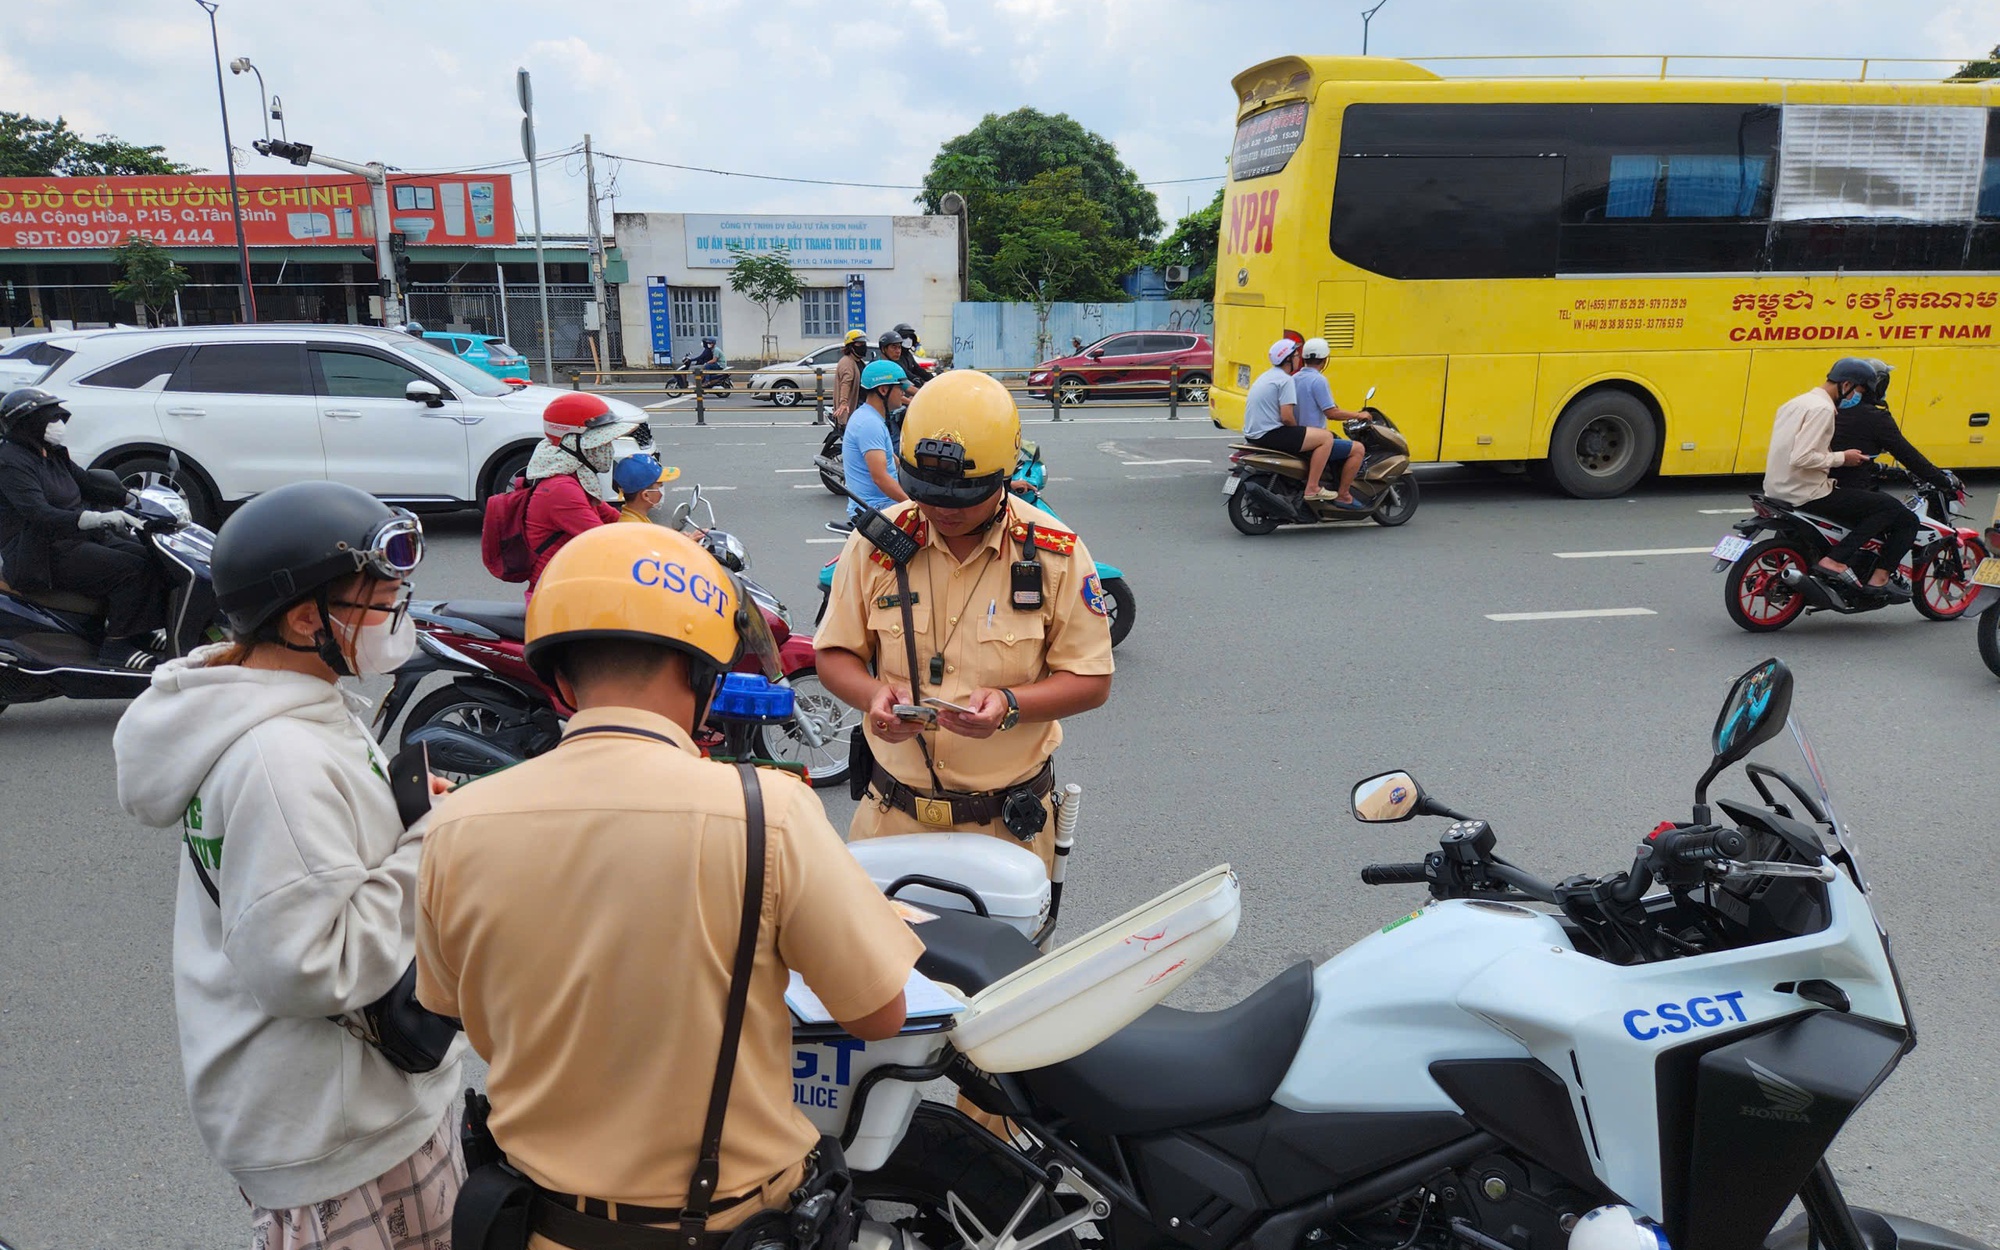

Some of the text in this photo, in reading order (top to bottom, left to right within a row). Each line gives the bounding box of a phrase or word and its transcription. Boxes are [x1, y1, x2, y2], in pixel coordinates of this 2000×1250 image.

[1282, 131, 1299, 139] 15:30
[21, 184, 65, 209] ĐỒ
[72, 184, 114, 208] CŨ
[120, 182, 250, 207] TRƯỜNG
[258, 186, 354, 206] CHINH
[41, 210, 88, 226] Cộng
[93, 210, 133, 225] Hòa,
[136, 209, 177, 224] P.15,
[181, 209, 232, 222] Q.Tân
[815, 221, 829, 230] TÂN
[1227, 189, 1279, 255] NPH
[15, 231, 62, 245] SĐT:
[67, 230, 120, 245] 0907
[173, 228, 215, 243] 444
[697, 235, 710, 252] DỰ
[711, 235, 723, 250] ÁN
[757, 237, 767, 250] XE
[788, 233, 802, 250] KẾT
[804, 237, 832, 250] TRANG
[834, 235, 857, 250] THIẾT
[859, 237, 868, 252] BỊ
[870, 238, 882, 250] HK
[1574, 299, 1586, 309] CPC
[1587, 299, 1607, 311] (+855)
[1608, 299, 1619, 309] 977
[1620, 299, 1628, 309] 85
[1628, 299, 1637, 309] 29
[1637, 299, 1645, 309] 29
[1650, 298, 1661, 309] 979
[1662, 298, 1669, 309] 73
[1670, 298, 1678, 308] 29
[1679, 298, 1687, 308] 29
[1559, 310, 1571, 320] TEL:
[1573, 319, 1582, 330] VN
[1582, 319, 1598, 330] (+84)
[1599, 319, 1607, 329] 28
[1608, 319, 1616, 329] 38
[1617, 319, 1625, 329] 38
[1625, 319, 1633, 329] 53
[1634, 319, 1642, 329] 53
[1646, 318, 1654, 328] 33
[1655, 318, 1667, 328] 776
[1667, 318, 1675, 328] 53
[1676, 318, 1684, 328] 53
[1729, 326, 1860, 342] CAMBODIA
[1879, 325, 1933, 340] VIET
[1938, 325, 1992, 339] NAM
[632, 558, 729, 618] CSGT
[1623, 990, 1748, 1041] C.S.G.T
[1738, 1105, 1811, 1124] HONDA
